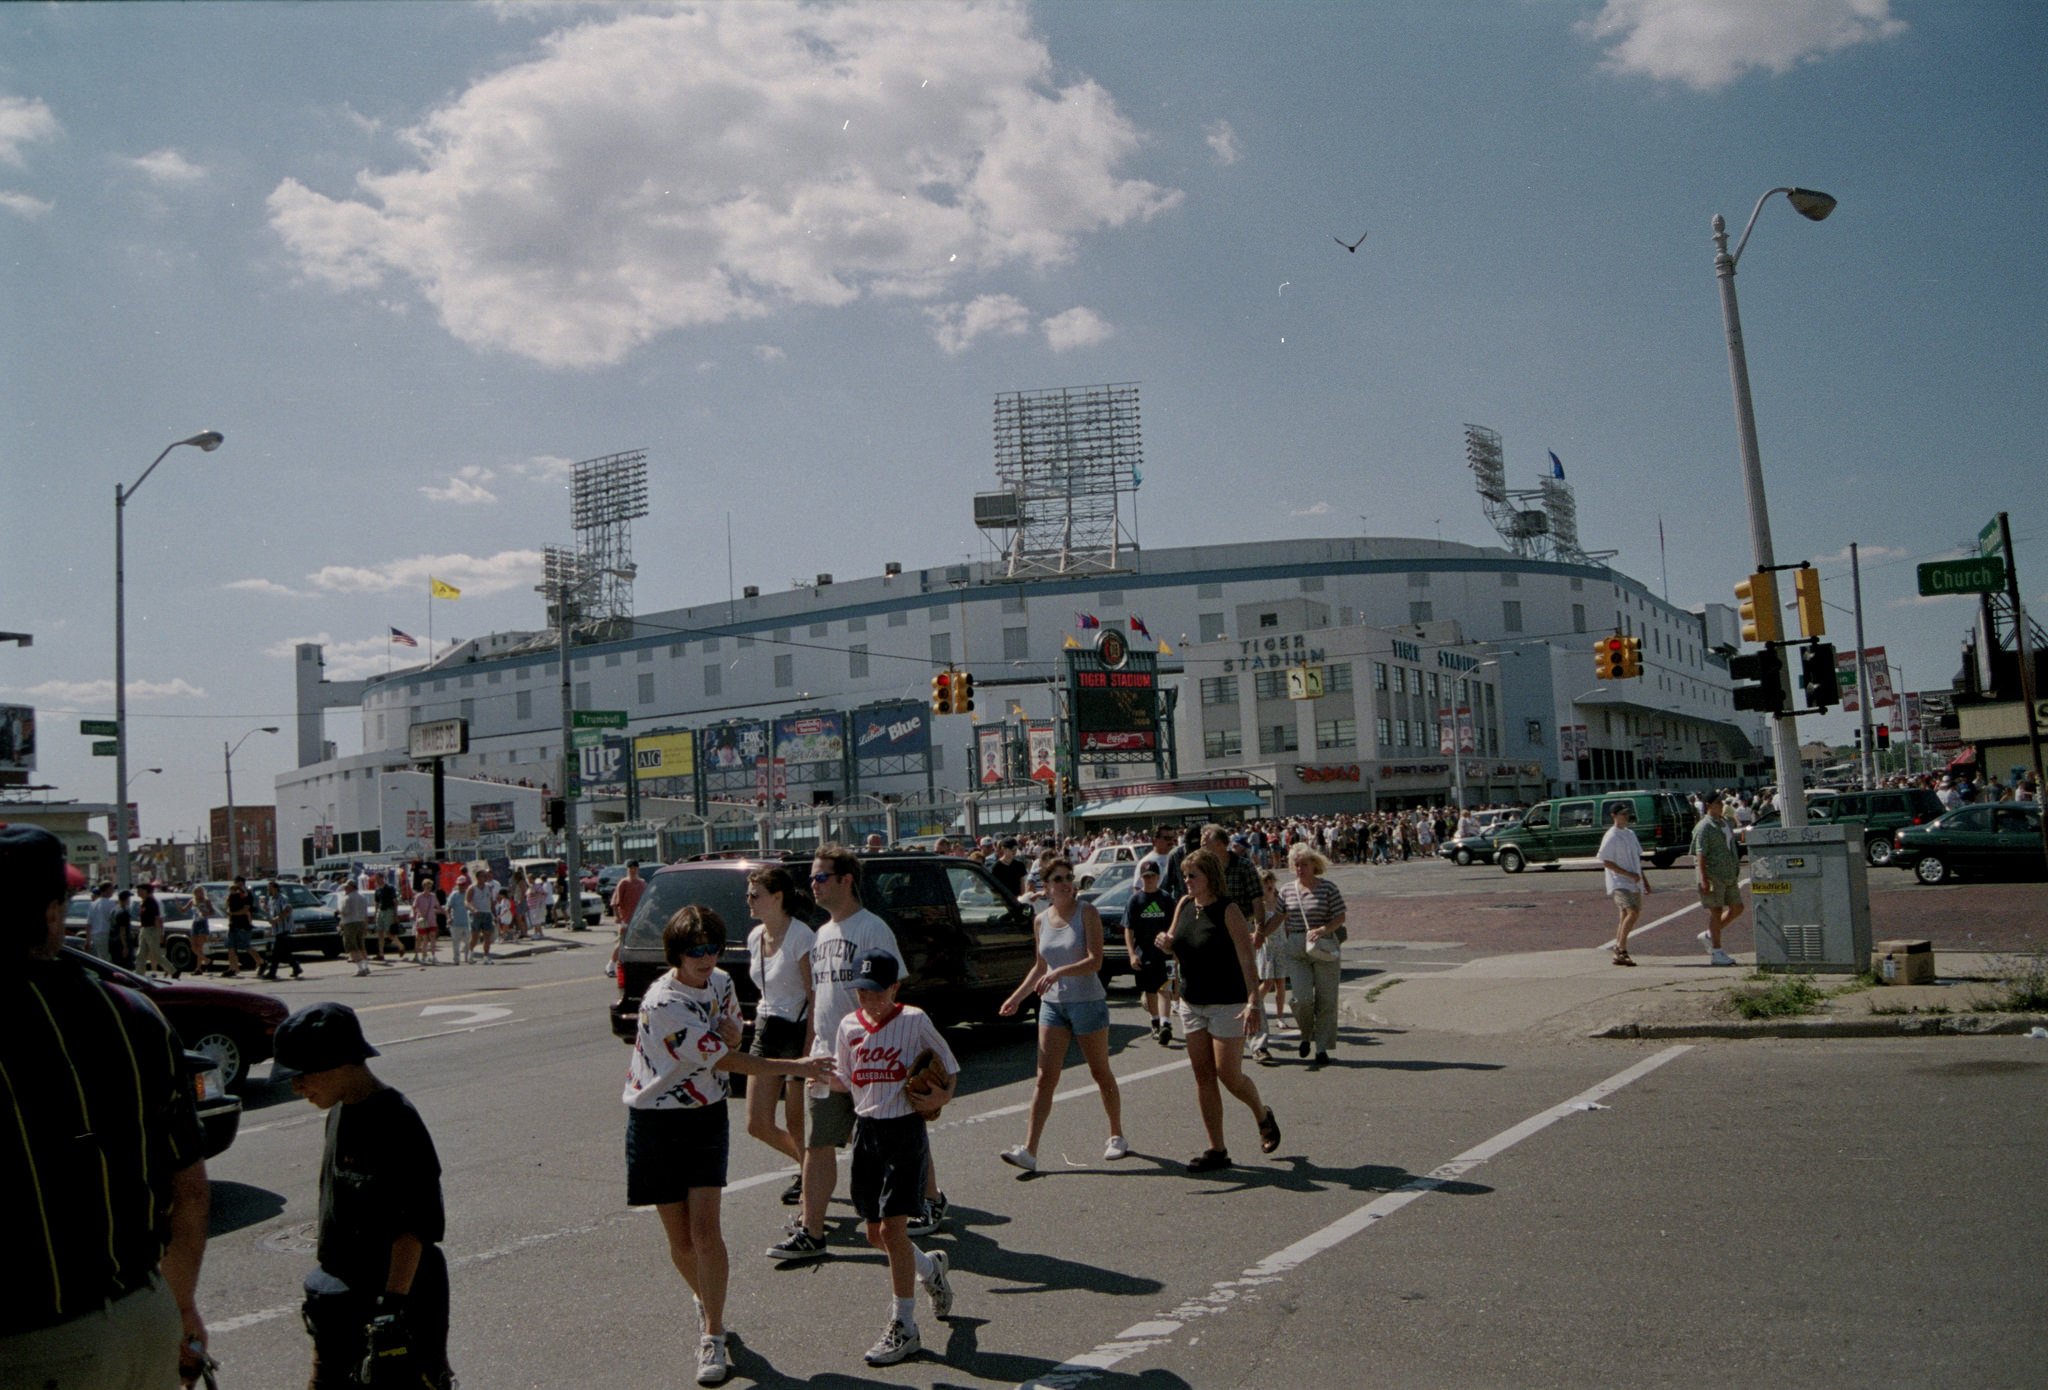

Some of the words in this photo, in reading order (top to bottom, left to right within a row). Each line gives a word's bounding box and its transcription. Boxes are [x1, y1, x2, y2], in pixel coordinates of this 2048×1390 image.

[1931, 567, 1992, 590] Church
[1240, 634, 1304, 654] TIGER
[1392, 639, 1421, 662] TIGER
[1223, 648, 1325, 672] STADIUM
[1079, 672, 1107, 687] TIGER
[1111, 673, 1152, 687] STADIUM
[581, 714, 620, 723] Trumbull
[887, 716, 921, 742] Blue
[858, 725, 886, 747] Labatt
[579, 745, 622, 781] Lite
[639, 751, 661, 767] AIG
[860, 960, 872, 974] D
[856, 1071, 895, 1081] BASEBALL
